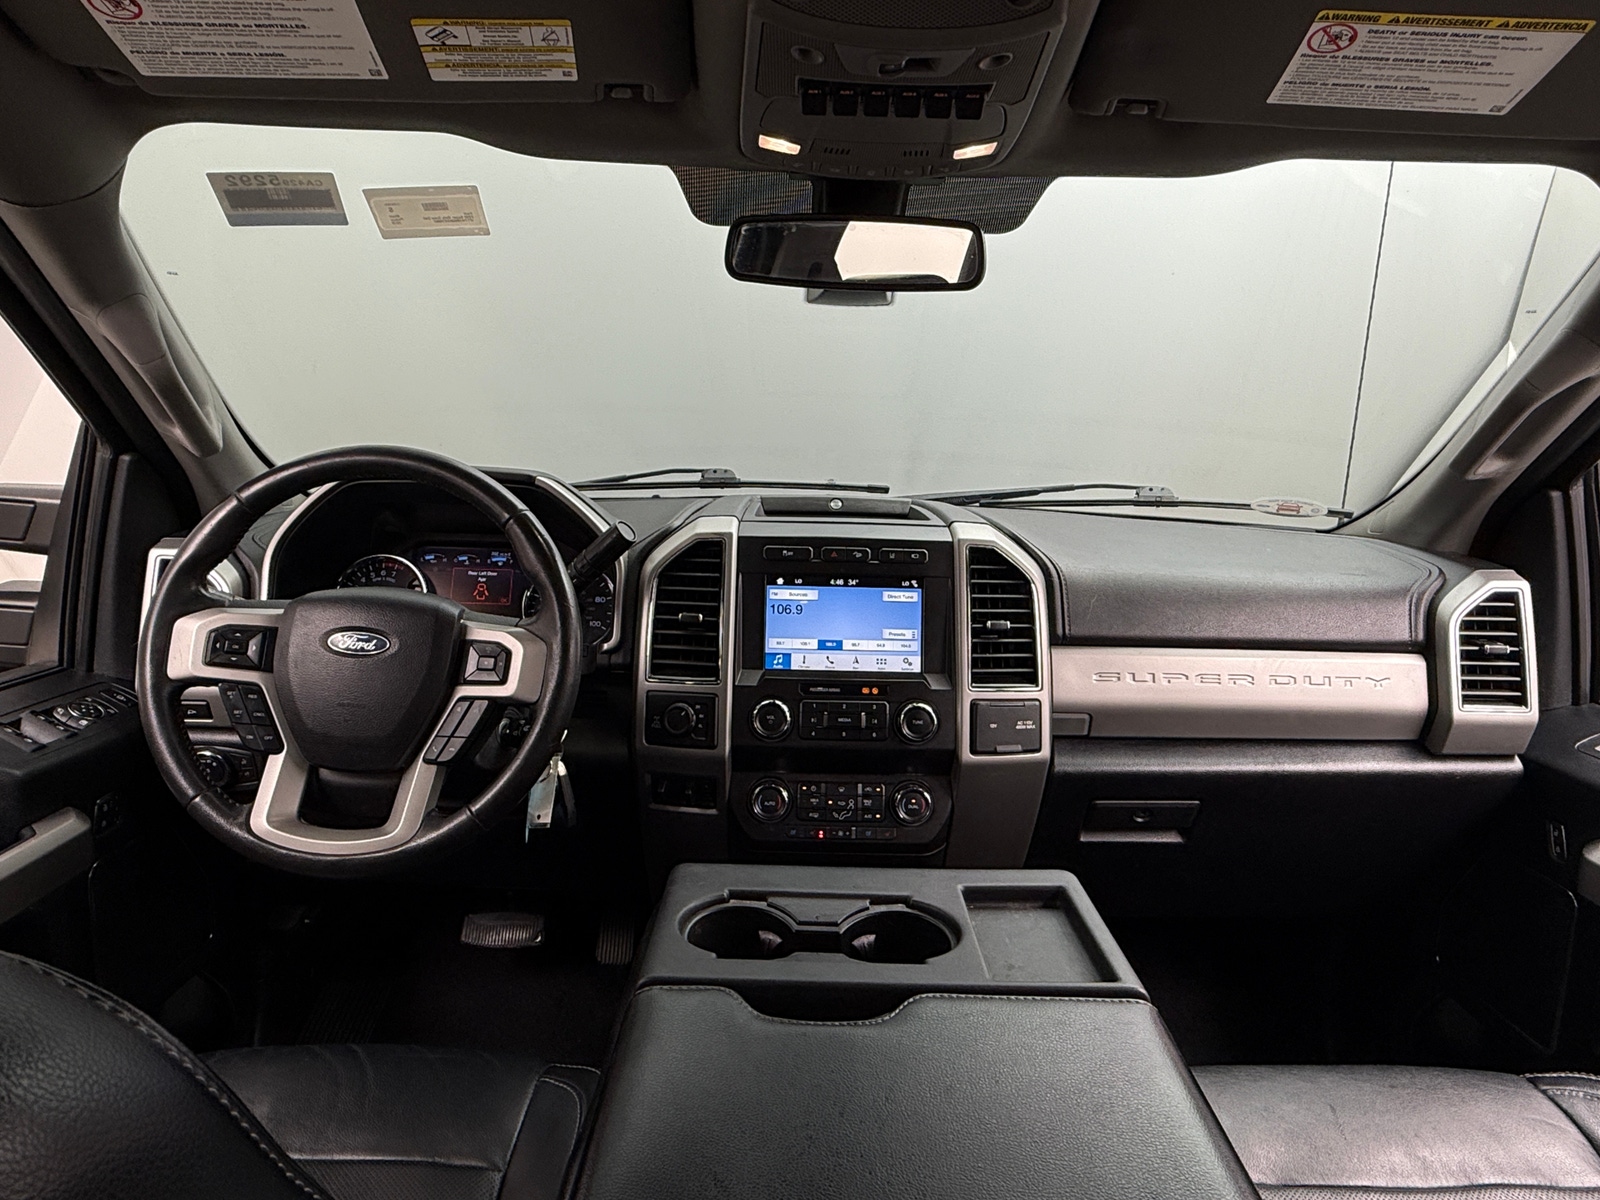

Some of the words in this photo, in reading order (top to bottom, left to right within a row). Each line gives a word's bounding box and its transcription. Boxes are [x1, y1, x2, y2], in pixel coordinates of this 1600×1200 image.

[1330, 13, 1381, 23] WARNING
[1401, 16, 1494, 27] AVERTISSEMENT
[1511, 21, 1589, 32] ADVERTENCIA
[770, 604, 803, 615] 106.9
[338, 633, 377, 650] Ford
[1093, 672, 1255, 686] SUPER
[1268, 674, 1391, 688] DUTY
